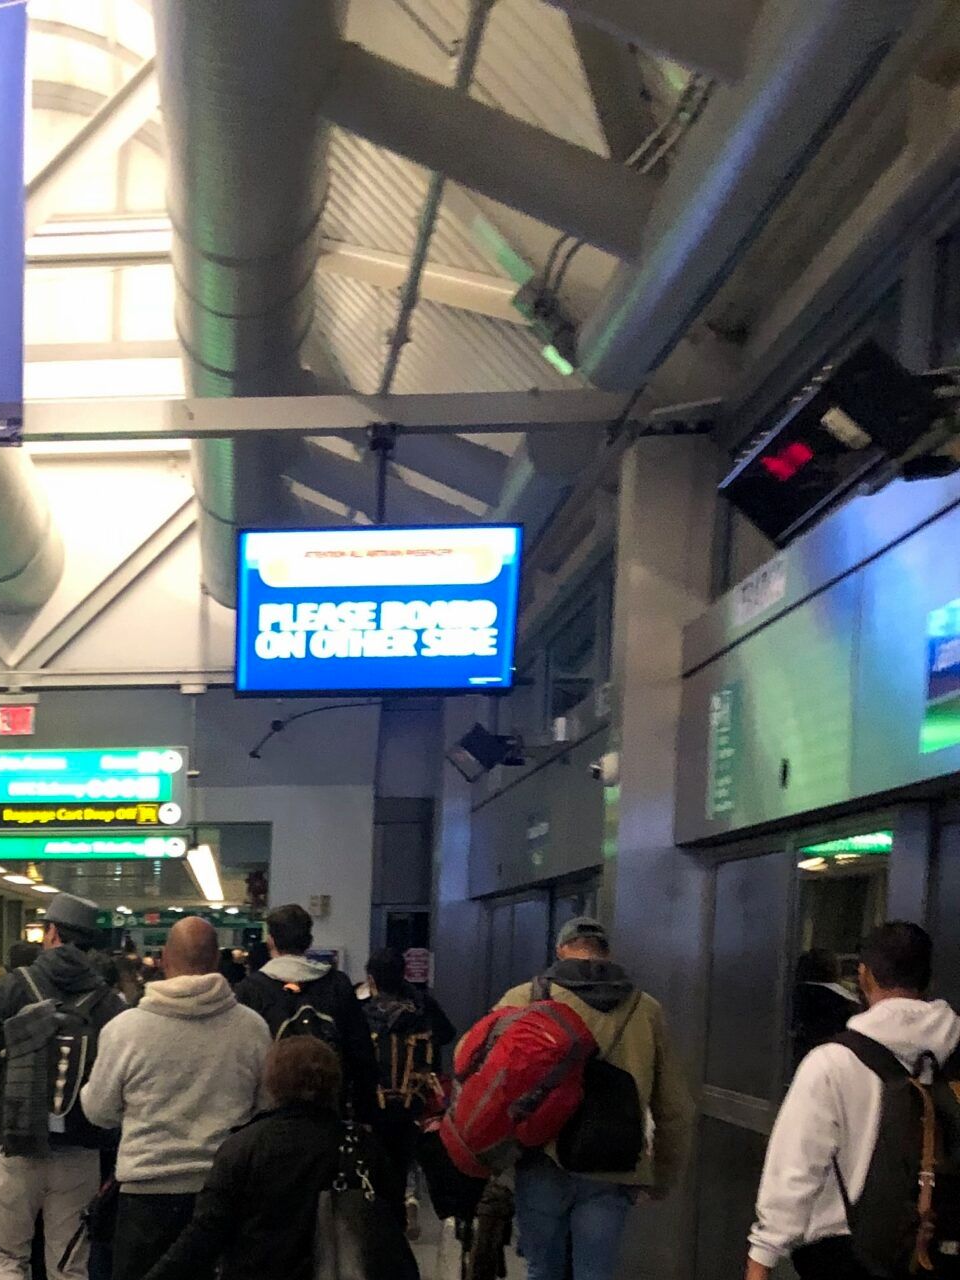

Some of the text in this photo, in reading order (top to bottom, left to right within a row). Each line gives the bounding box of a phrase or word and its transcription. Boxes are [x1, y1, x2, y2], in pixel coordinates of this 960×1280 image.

[258, 599, 498, 631] PLEASE BOARD
[254, 627, 498, 659] ON OTHER SIDE
